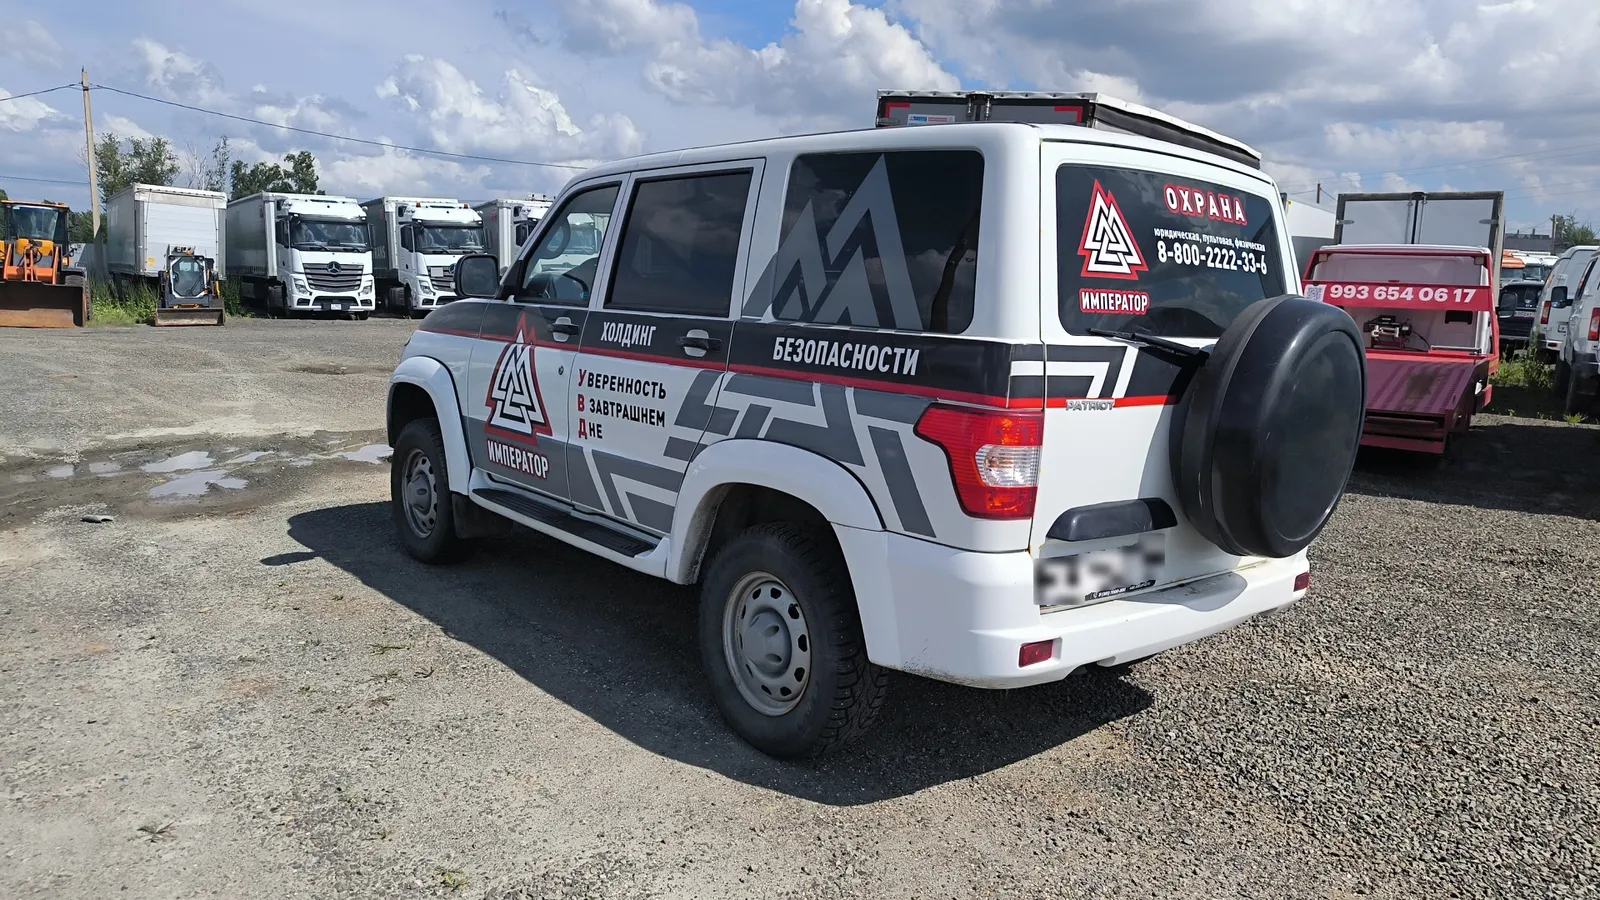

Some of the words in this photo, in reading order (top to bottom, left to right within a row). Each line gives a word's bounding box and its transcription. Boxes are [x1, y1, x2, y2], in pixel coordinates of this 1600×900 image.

[1165, 186, 1245, 222] ОХРАНА
[1154, 227, 1202, 243] юридическая,
[1202, 234, 1234, 249] пультовая,
[1234, 236, 1266, 252] физическая
[1157, 240, 1267, 275] 8-800-2222-33-6
[1081, 291, 1148, 312] ИМПЕРАТОР
[1330, 284, 1369, 299] 993
[1373, 286, 1414, 301] 654
[1418, 287, 1448, 302] 06
[1453, 288, 1477, 303] 17
[600, 321, 656, 348] ХОЛДИНГ
[773, 336, 920, 376] БЕЗОПАСНОСТИ
[578, 369, 667, 399] УВЕРЕННОСТЬ
[577, 394, 585, 412] В
[589, 399, 666, 427] ЗАВТРАШНЕМ
[1065, 400, 1115, 411] PATRIOT
[578, 419, 603, 439] ДНЕ
[487, 440, 549, 479] ИМПЕРАТОР
